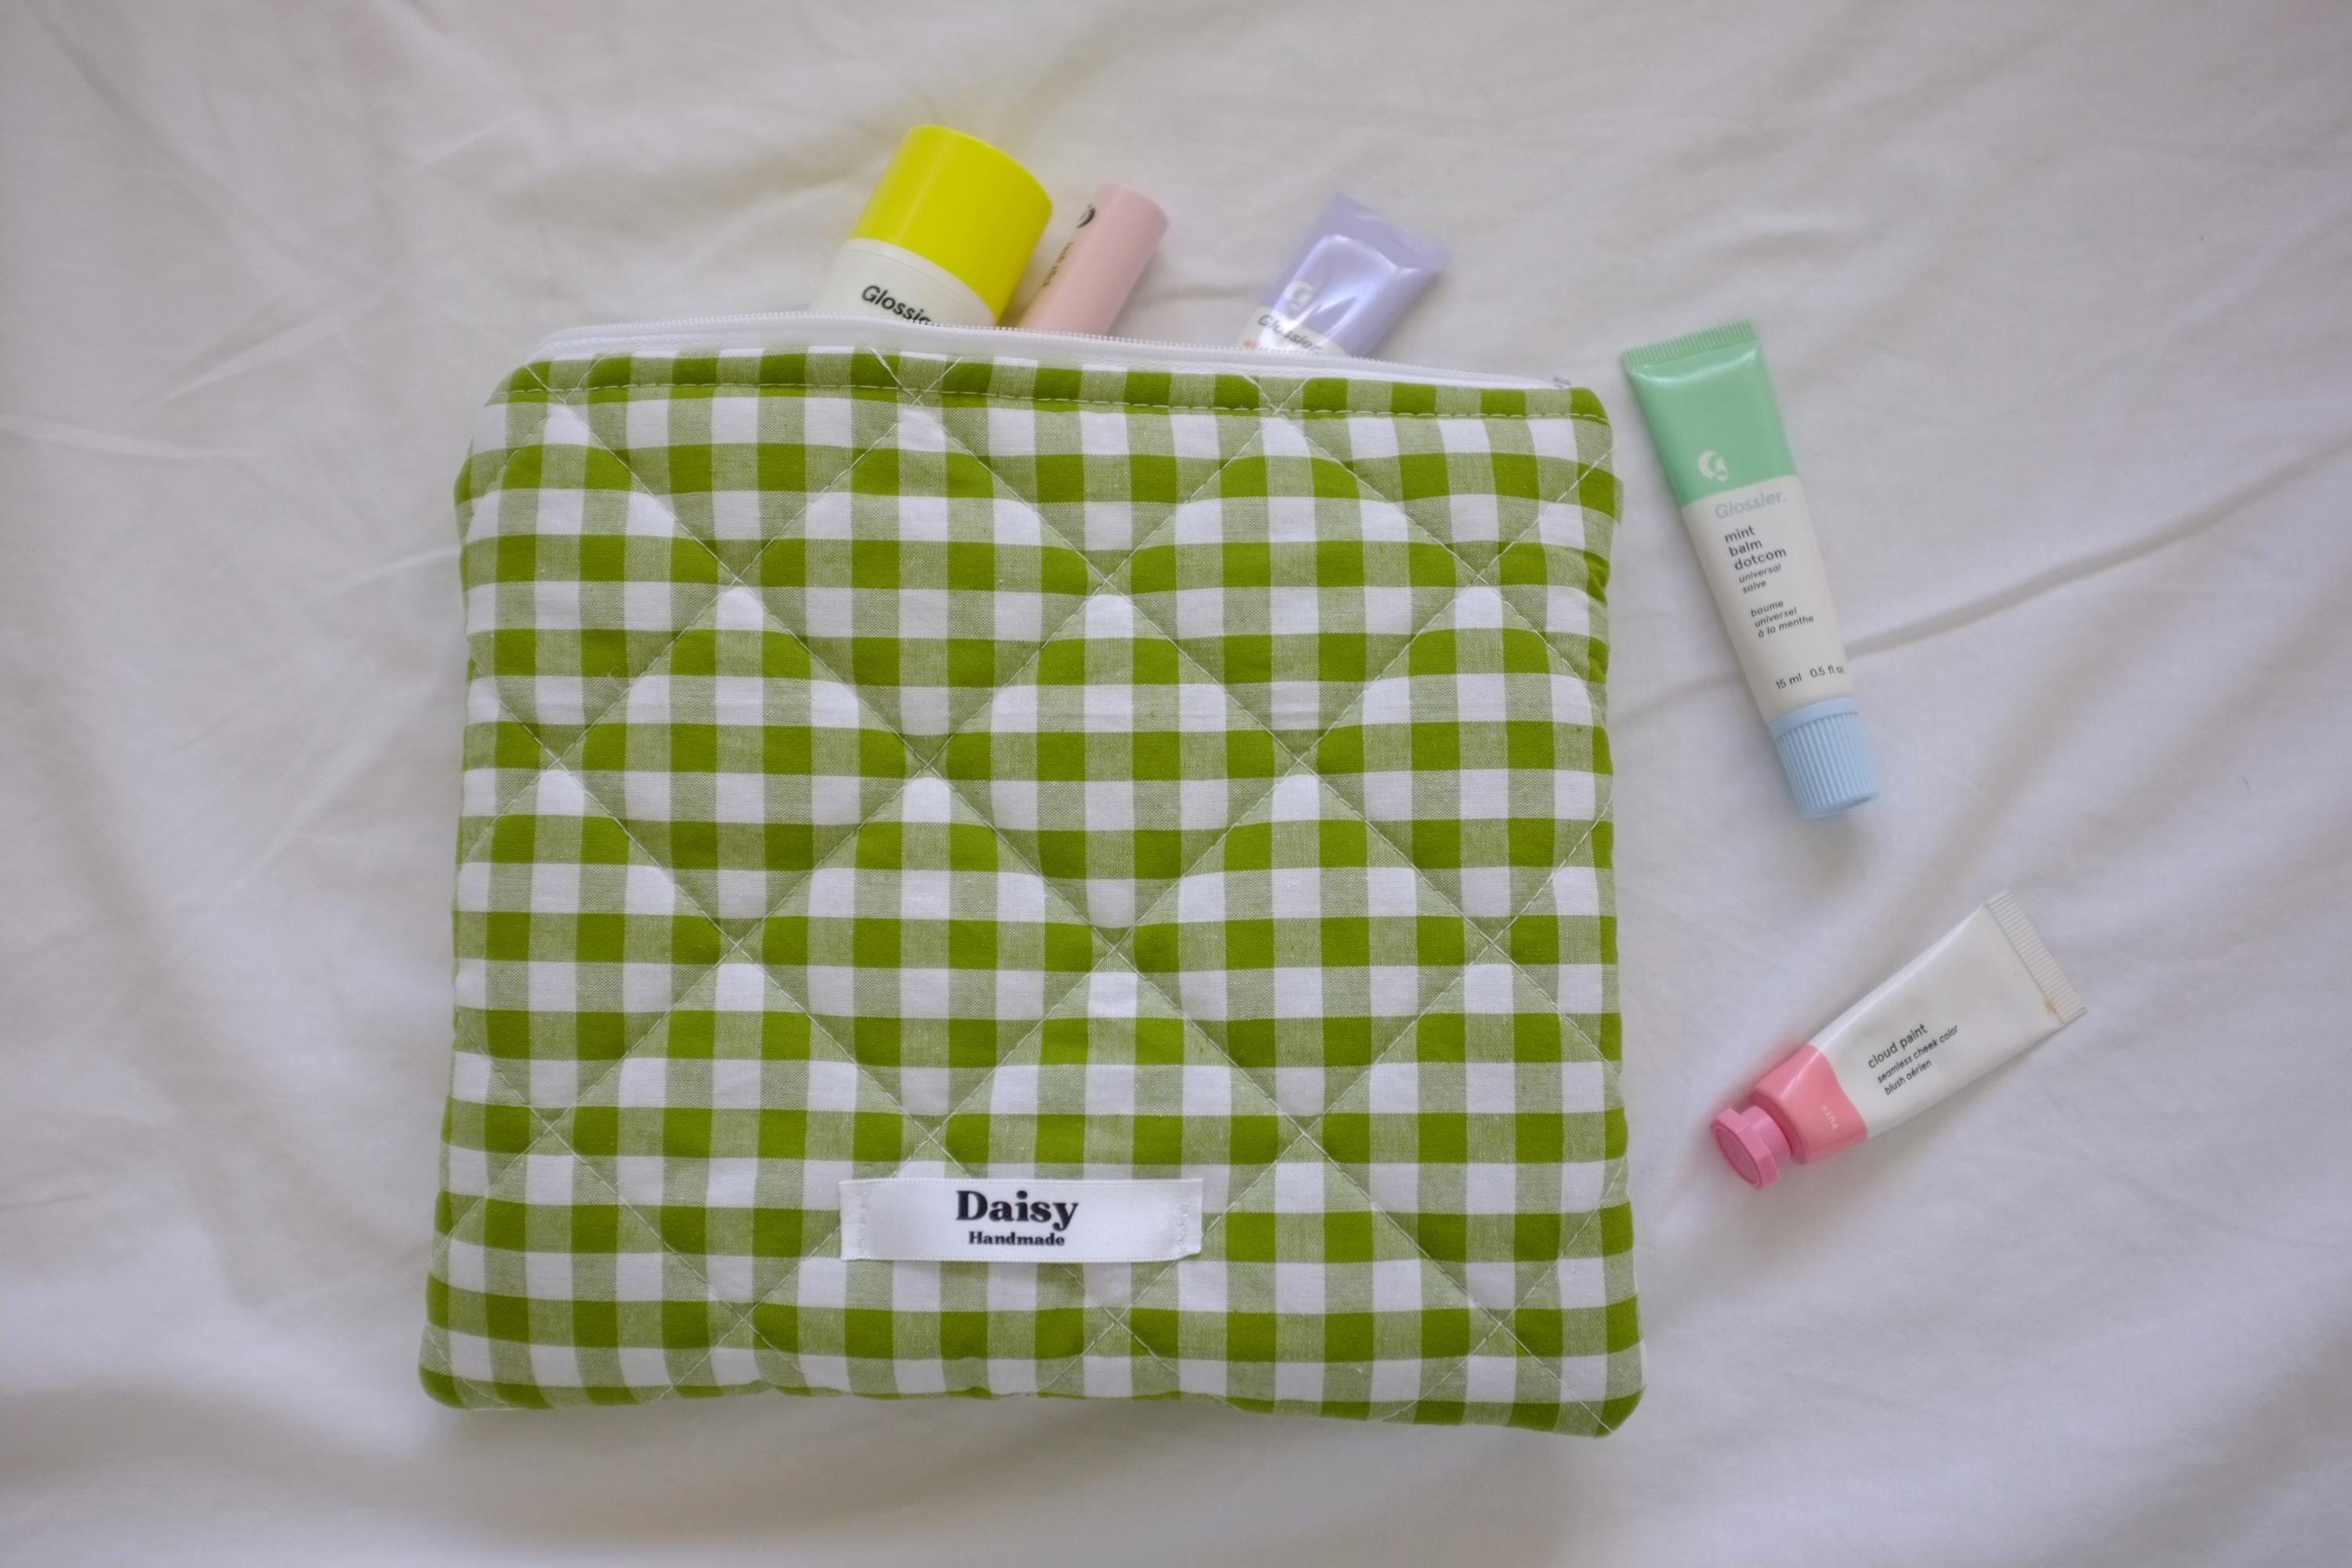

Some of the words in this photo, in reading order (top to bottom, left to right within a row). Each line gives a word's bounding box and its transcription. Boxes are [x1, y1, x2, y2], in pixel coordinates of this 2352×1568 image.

[1724, 525, 1755, 543] mint
[1728, 539, 1763, 557] balm
[1734, 548, 1788, 571] dotcom
[1738, 563, 1782, 583] universal
[1742, 579, 1767, 594] salve
[1750, 601, 1784, 618] baume
[1754, 607, 1798, 628] universel
[1766, 626, 1777, 635] la
[1778, 615, 1815, 630] menthe
[1775, 679, 1788, 690] 15
[1788, 673, 1803, 685] ml
[1809, 666, 1826, 678] 0.5
[1828, 665, 1835, 674] fl
[1867, 1043, 1899, 1069] cloud
[1899, 1023, 1929, 1051] paint
[1877, 1054, 1913, 1083] seamless
[1913, 1039, 1939, 1059] cheek
[1939, 1025, 1958, 1044] color
[1884, 1076, 1906, 1095] blush
[1906, 1059, 1933, 1080] aérien
[956, 1189, 1079, 1232] Daisy
[967, 1230, 1065, 1247] Handmade
